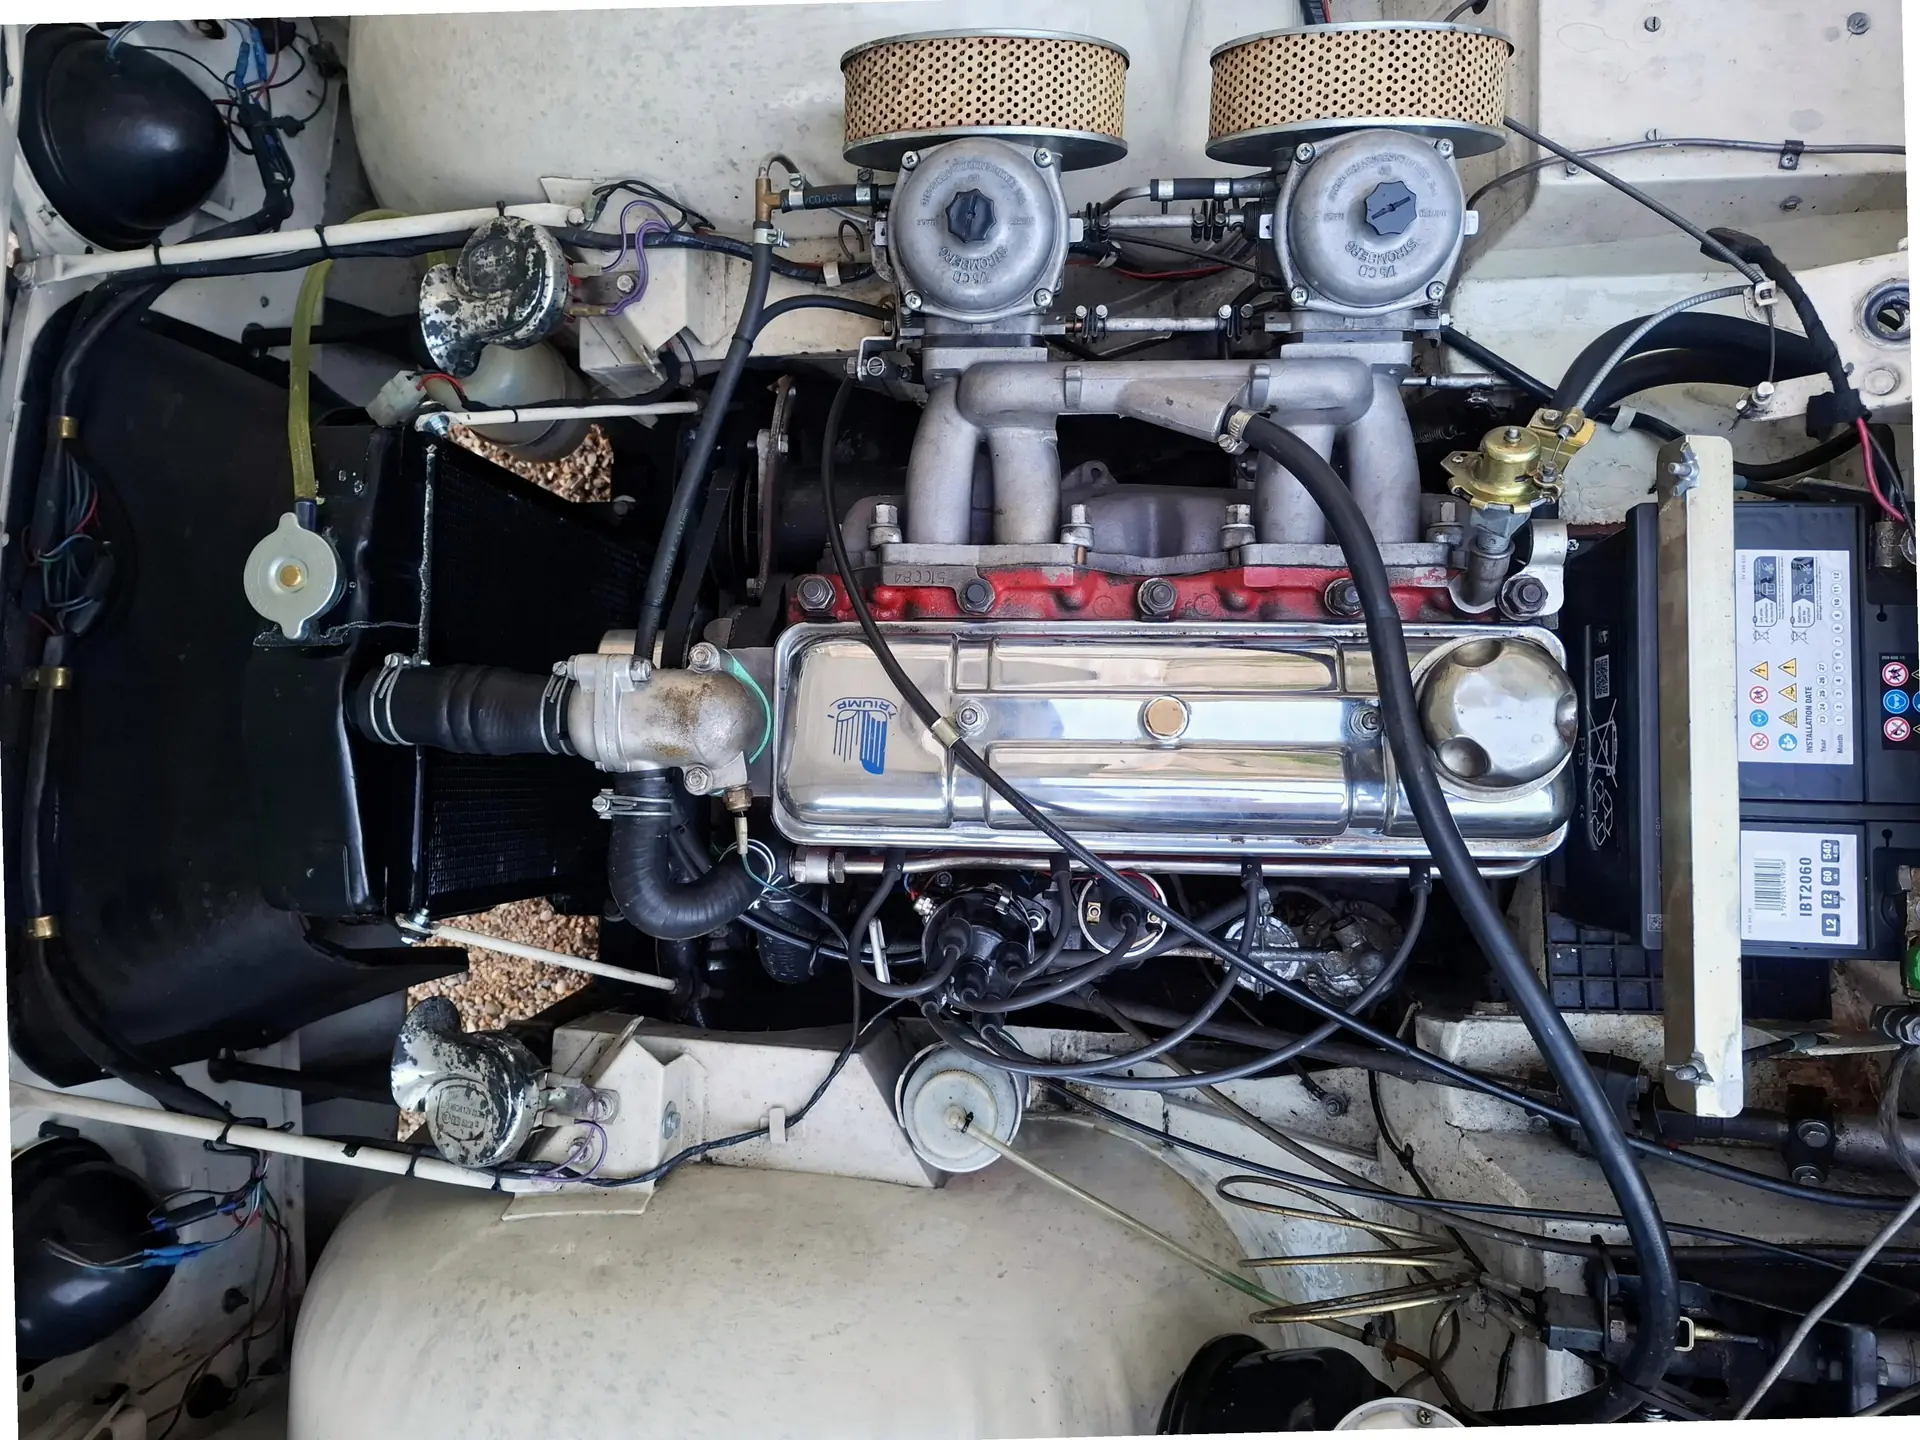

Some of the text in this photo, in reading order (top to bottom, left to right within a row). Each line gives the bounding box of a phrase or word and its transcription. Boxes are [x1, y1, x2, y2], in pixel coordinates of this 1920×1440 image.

[938, 246, 1009, 271] STROMBERG
[1345, 238, 1419, 264] STROMBERG
[1804, 686, 1813, 753] INSTALLATION DATE
[1822, 842, 1833, 860] 540
[1822, 870, 1833, 882] 60
[1799, 857, 1812, 917] IBT2060
[1822, 893, 1833, 905] 12
[1825, 918, 1837, 932] L2
